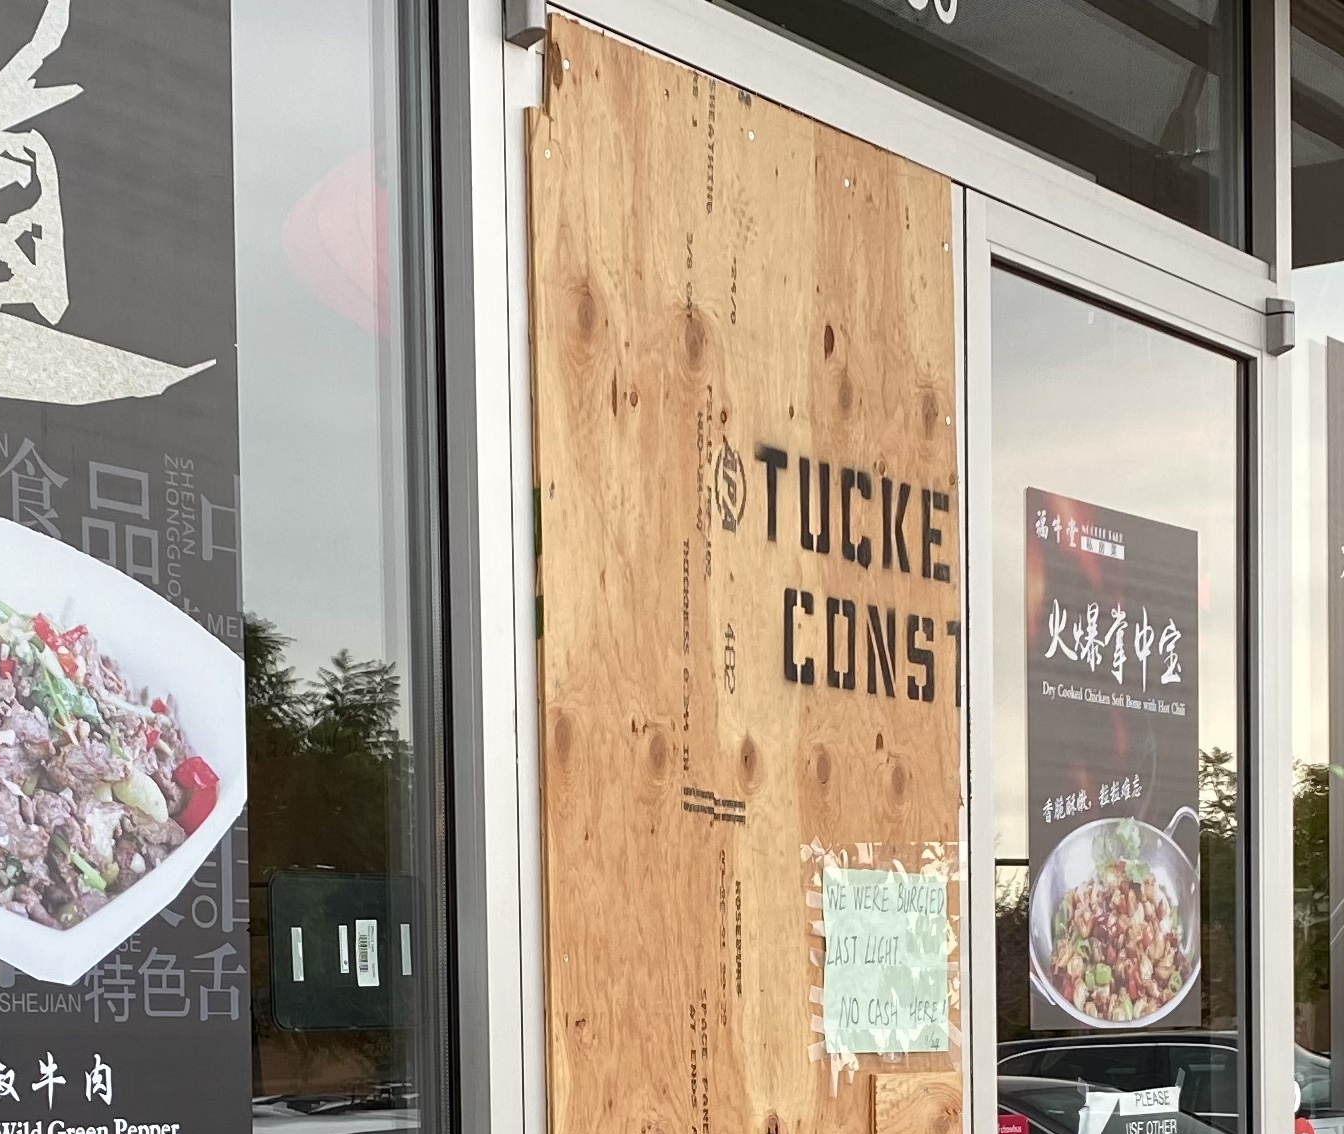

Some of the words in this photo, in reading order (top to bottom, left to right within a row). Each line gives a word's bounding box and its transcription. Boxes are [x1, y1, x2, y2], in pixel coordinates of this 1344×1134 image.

[179, 458, 196, 556] SHEJIAN
[755, 444, 951, 583] TUCKE
[1043, 680, 1056, 700] Dry
[1057, 683, 1083, 701] Cooked
[1084, 687, 1110, 705] Chicken
[827, 883, 847, 910] WE
[853, 884, 890, 913] WERE
[827, 933, 858, 966] LAST
[839, 995, 860, 1028] NO
[867, 997, 899, 1027] CASH
[1134, 1090, 1170, 1107] PLEASE
